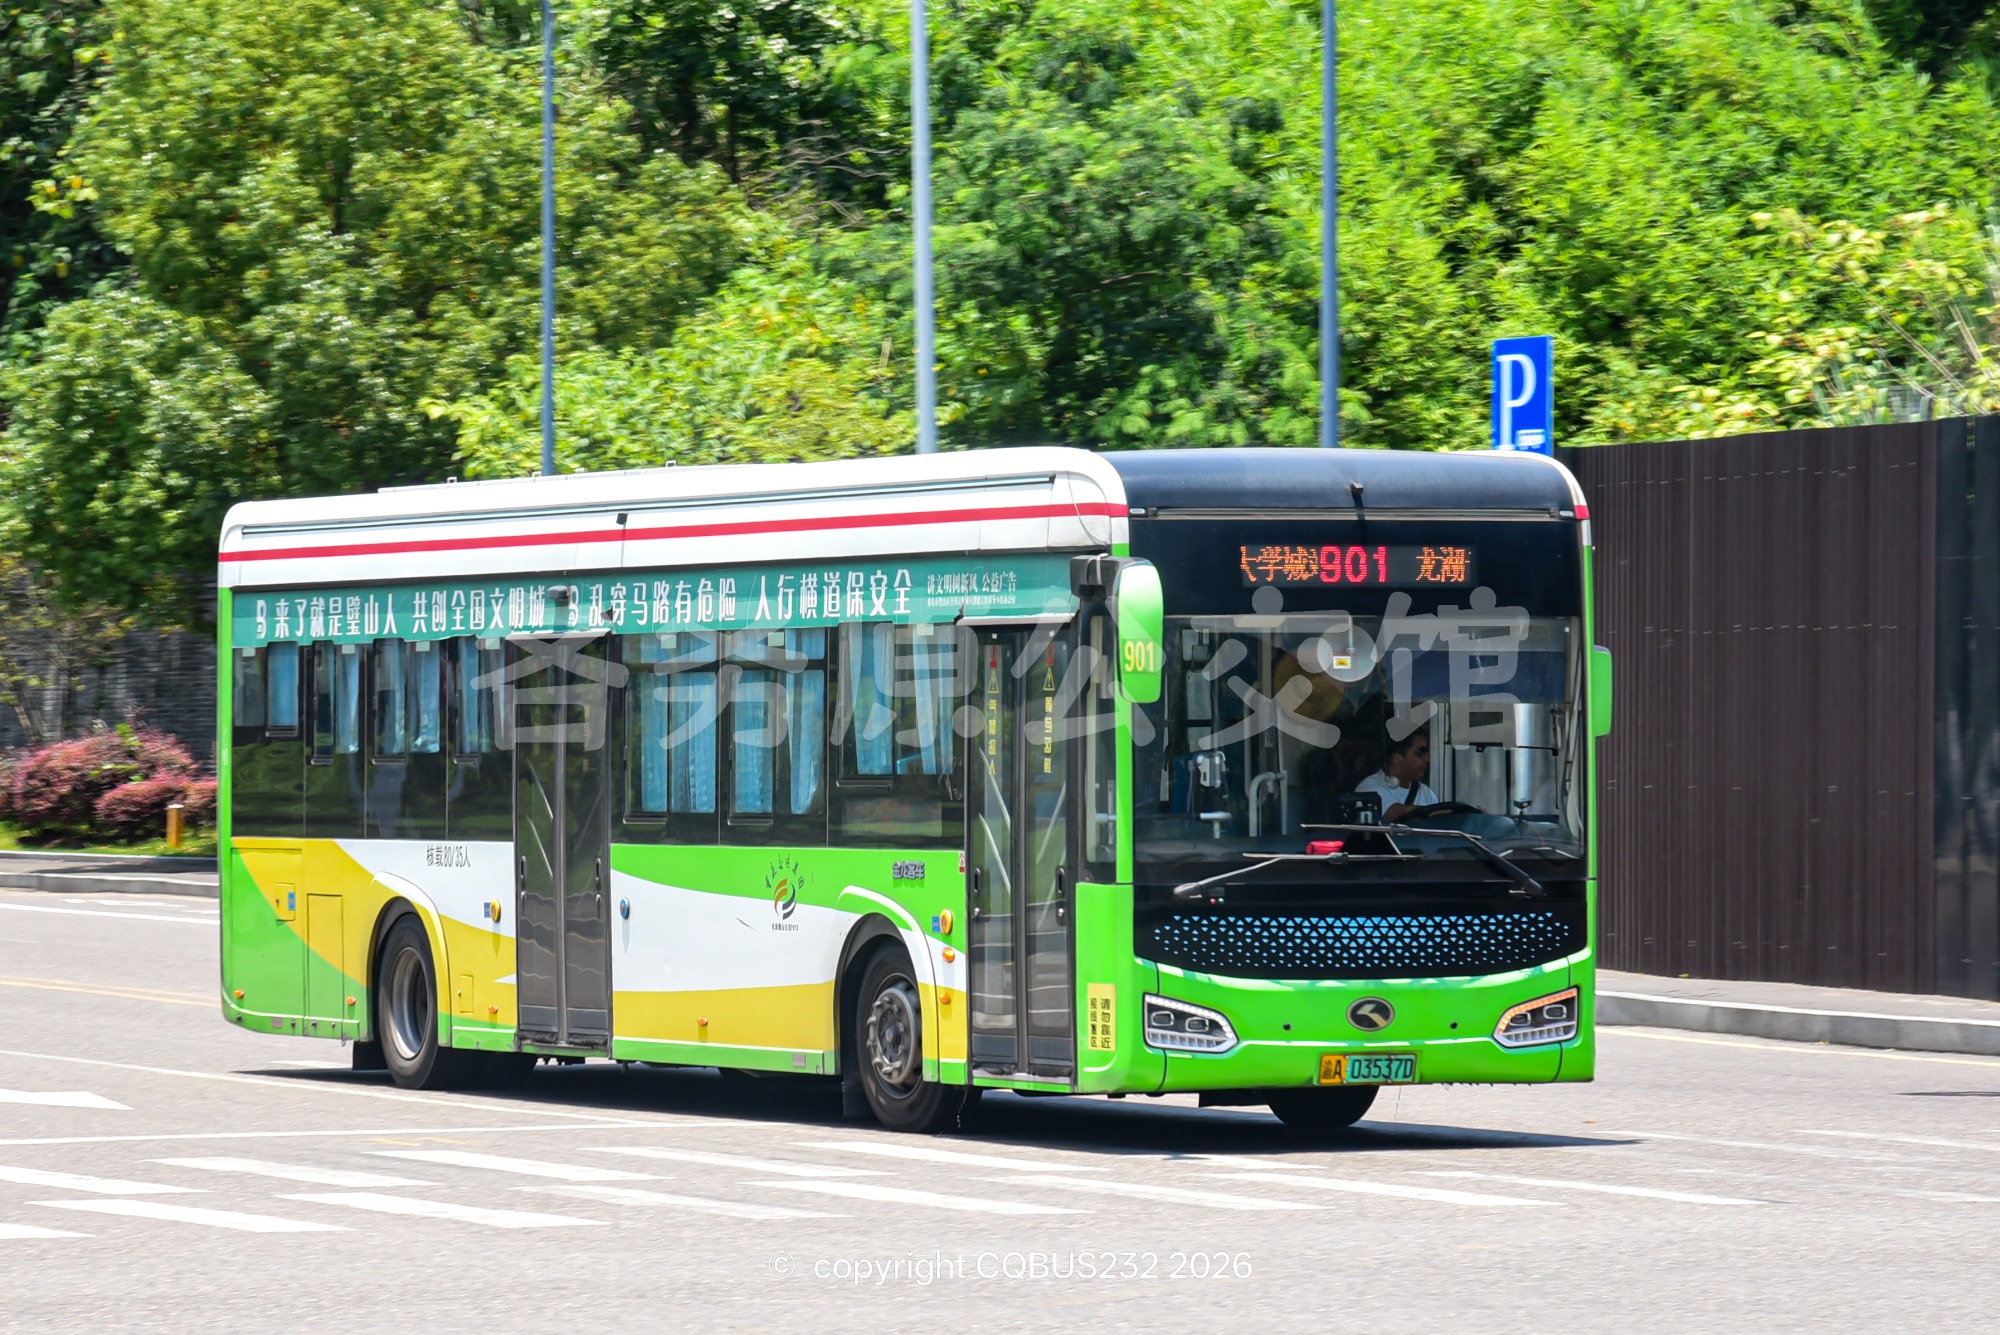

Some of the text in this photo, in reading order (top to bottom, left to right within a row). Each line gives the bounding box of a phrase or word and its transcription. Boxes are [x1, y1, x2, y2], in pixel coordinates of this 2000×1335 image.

[1496, 353, 1537, 451] P
[982, 571, 1017, 592] 公益广告
[1320, 545, 1388, 583] 901
[588, 577, 737, 627] 乱穿马路有危险
[754, 569, 912, 621] 人行横道保安全
[1125, 640, 1155, 672] 901
[1100, 998, 1111, 1049] 请勿靠近
[1351, 1058, 1413, 1079] 03537D
